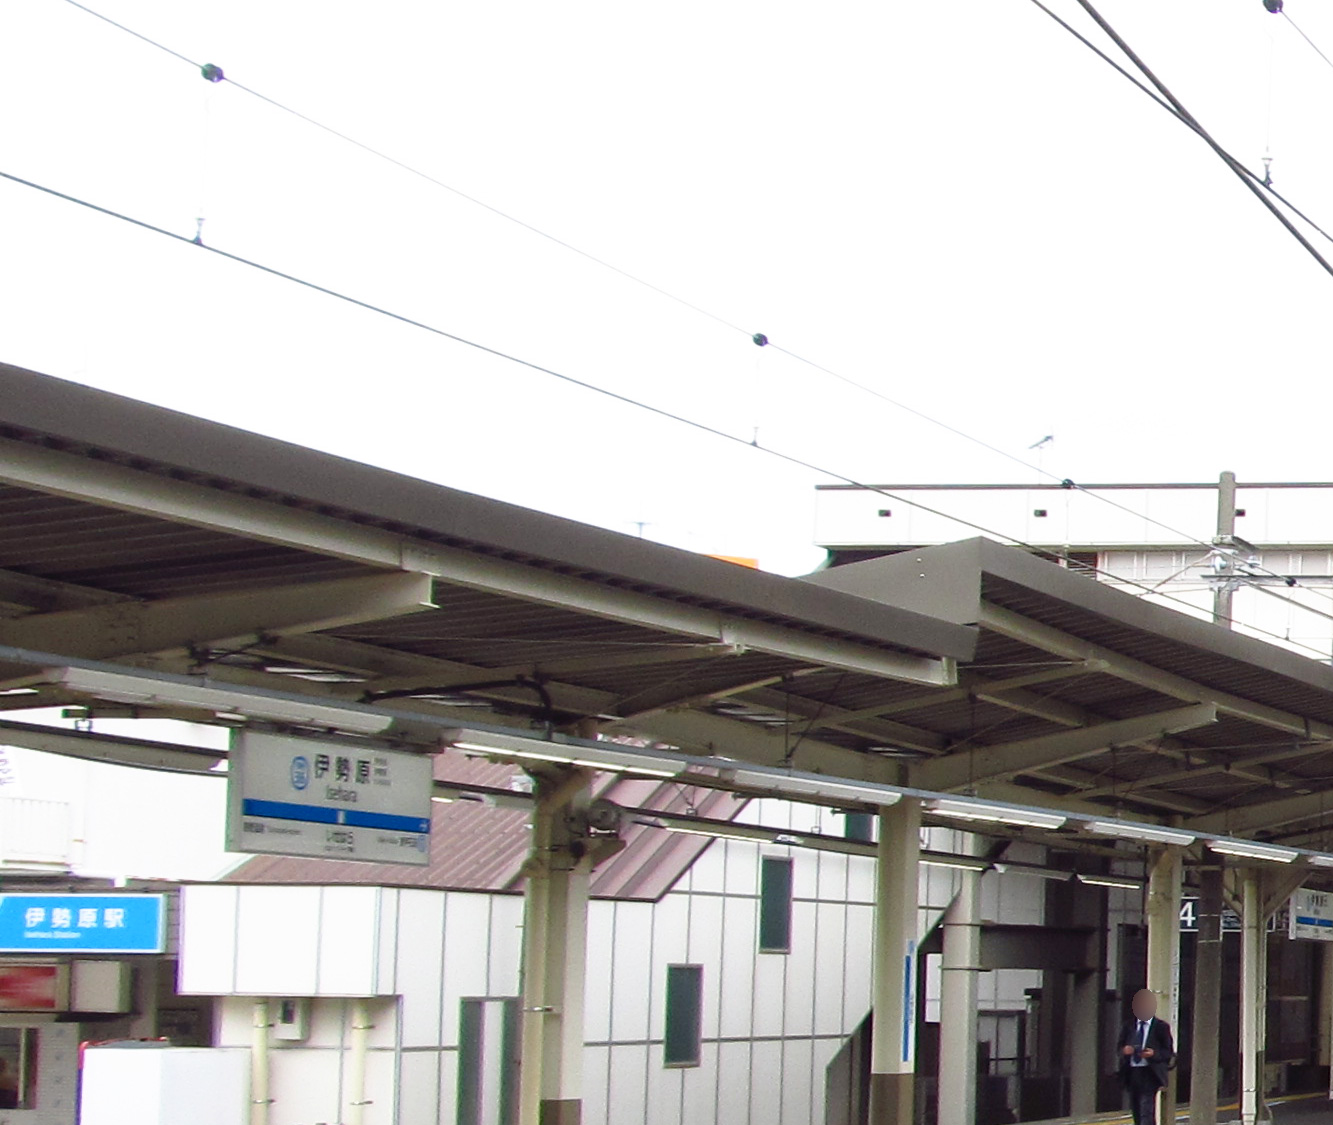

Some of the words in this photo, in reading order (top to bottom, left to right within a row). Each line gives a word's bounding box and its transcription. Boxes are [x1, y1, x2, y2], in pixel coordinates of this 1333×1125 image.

[25, 907, 125, 928] 伊勢原駅
[1180, 901, 1196, 927] 4
